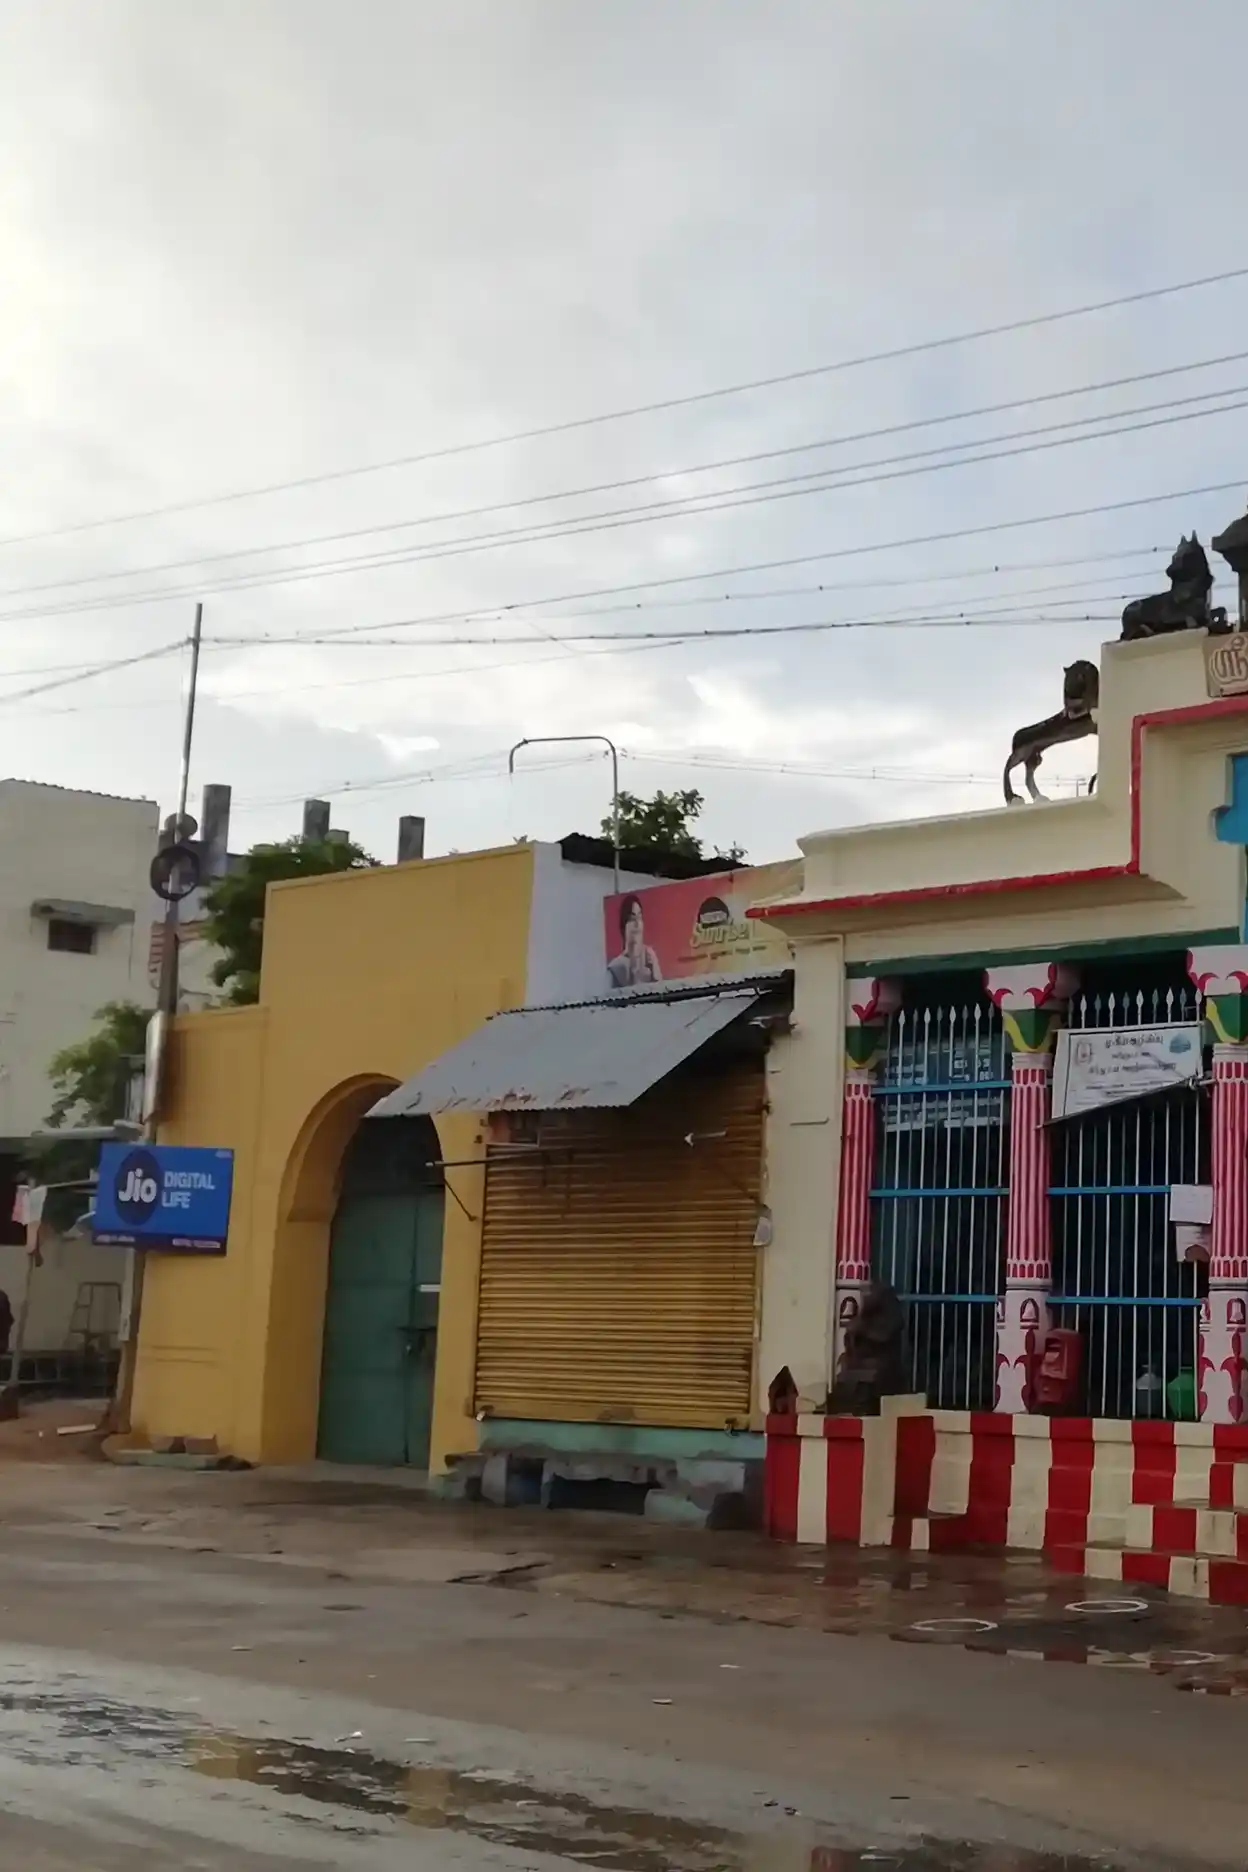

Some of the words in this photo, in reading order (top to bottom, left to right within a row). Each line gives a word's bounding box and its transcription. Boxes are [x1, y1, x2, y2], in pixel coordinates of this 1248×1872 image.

[118, 1167, 158, 1204] Jio
[163, 1171, 216, 1191] DIGITAL
[161, 1191, 192, 1209] LIFE
